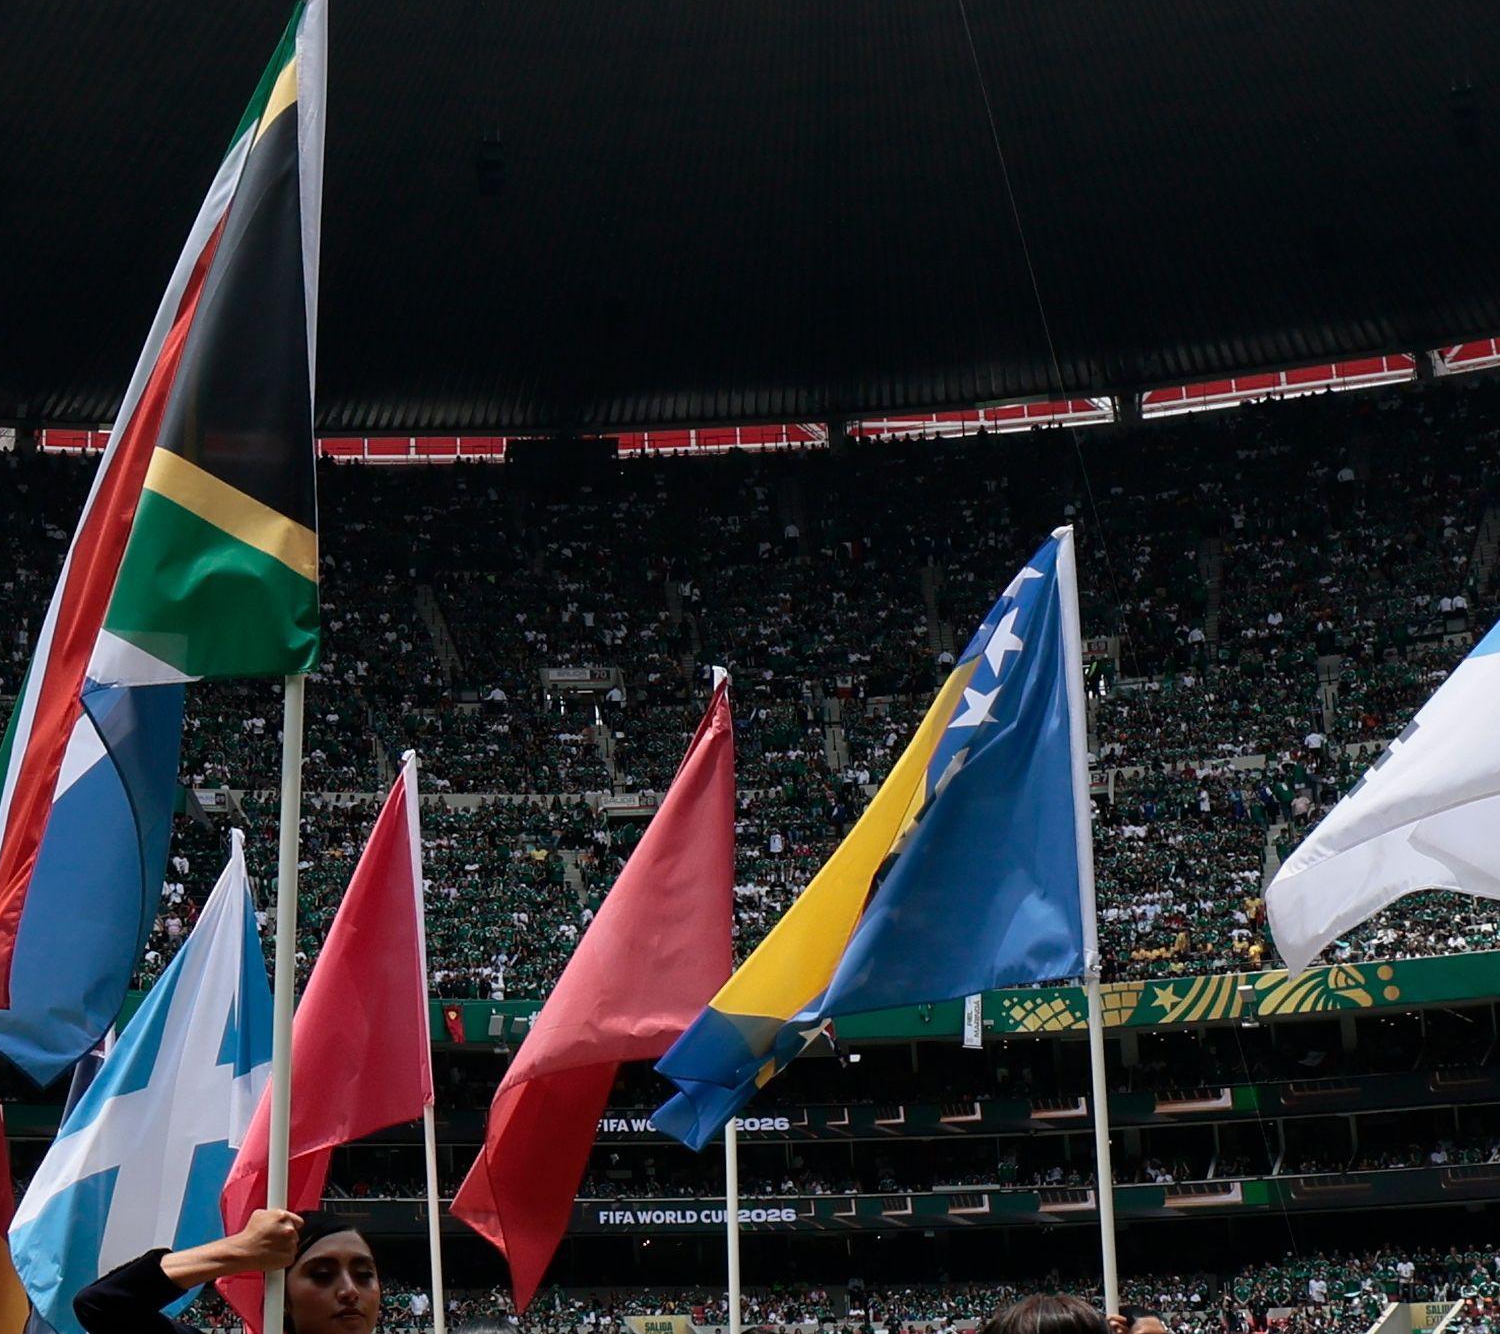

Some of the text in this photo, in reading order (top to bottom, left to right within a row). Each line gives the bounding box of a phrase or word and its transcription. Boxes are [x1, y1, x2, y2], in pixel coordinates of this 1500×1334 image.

[596, 1118, 631, 1133] FIFA
[735, 1117, 790, 1132] 2026
[599, 1210, 634, 1224] FIFA
[636, 1210, 697, 1224] WORLD
[738, 1208, 797, 1223] 2026
[645, 1321, 673, 1331] SALIDA
